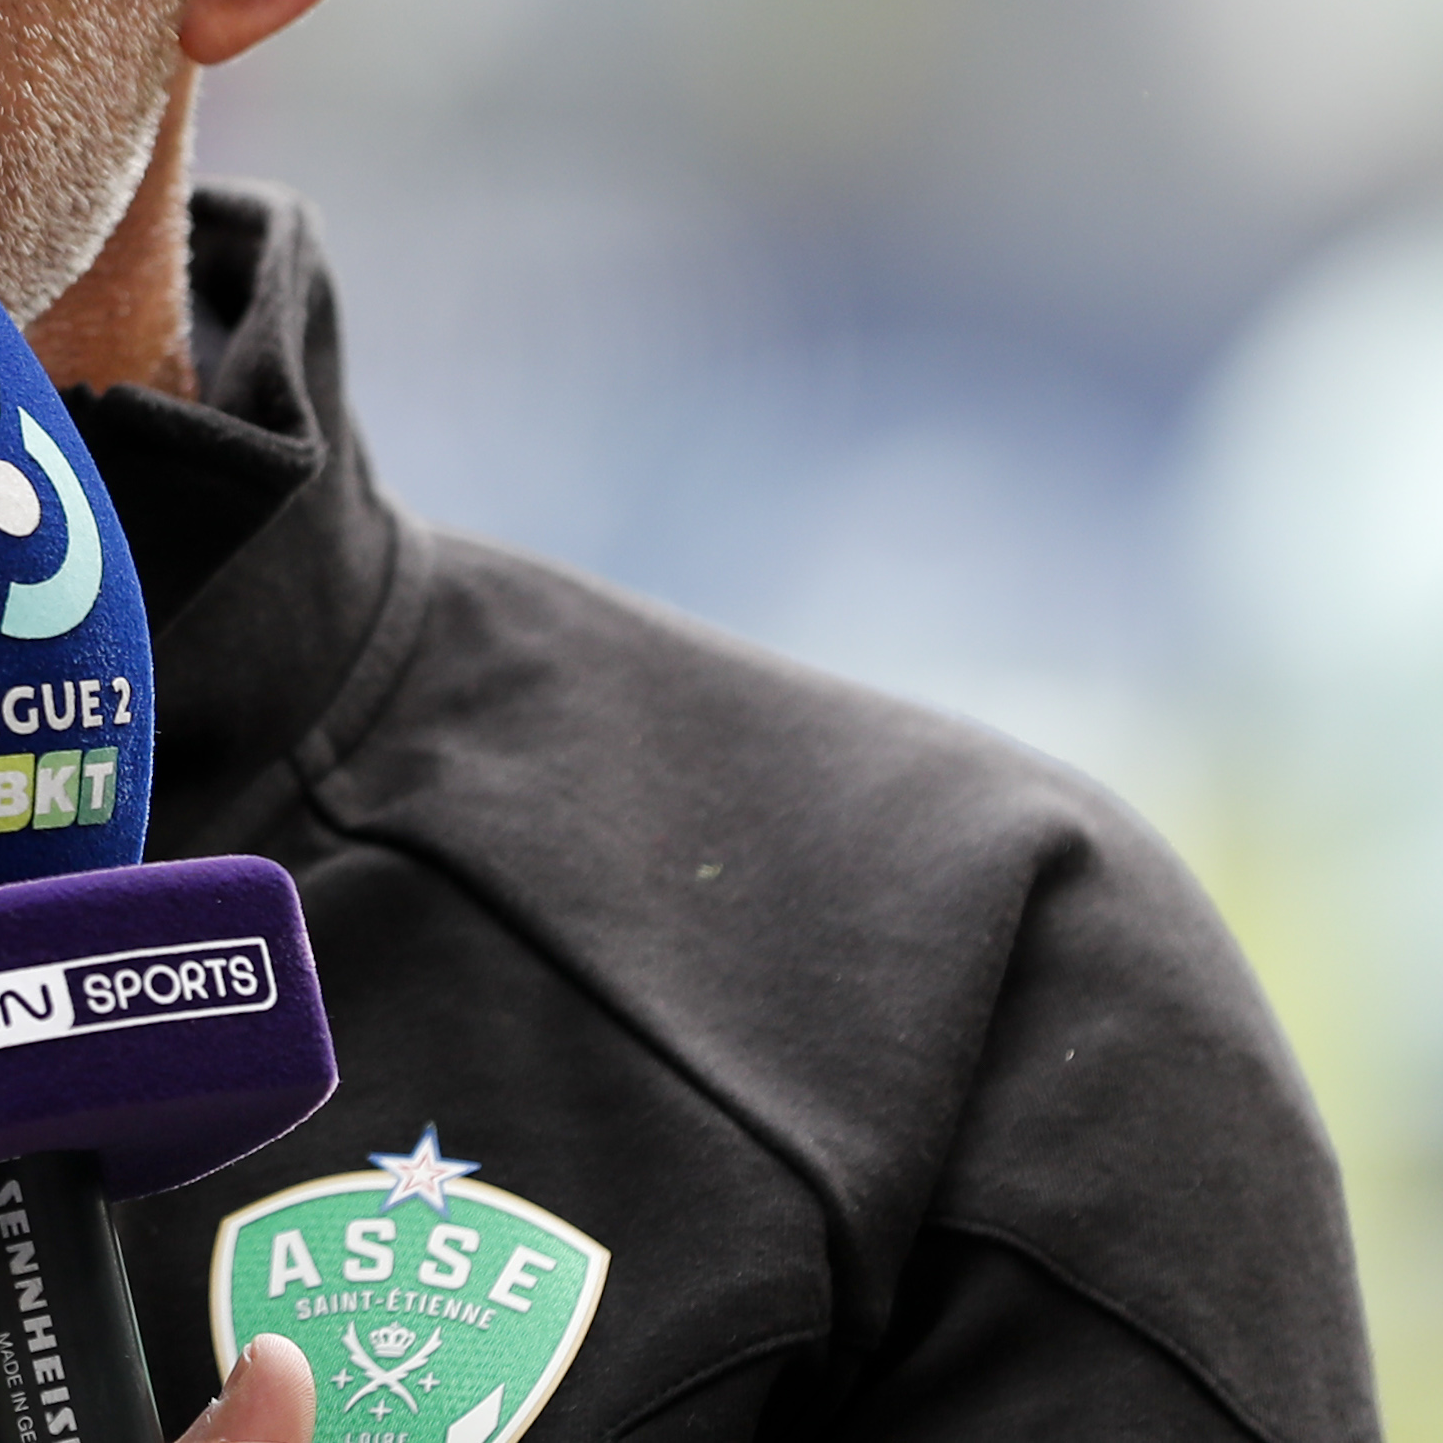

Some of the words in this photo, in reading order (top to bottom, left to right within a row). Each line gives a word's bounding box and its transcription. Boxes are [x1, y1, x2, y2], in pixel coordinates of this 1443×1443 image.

[110, 676, 132, 726] 2
[83, 955, 259, 1015] SPORTS
[267, 1217, 558, 1314] ASSE
[295, 1286, 498, 1331] SAINT-ÉTIENNE
[10, 1391, 30, 1413] IN
